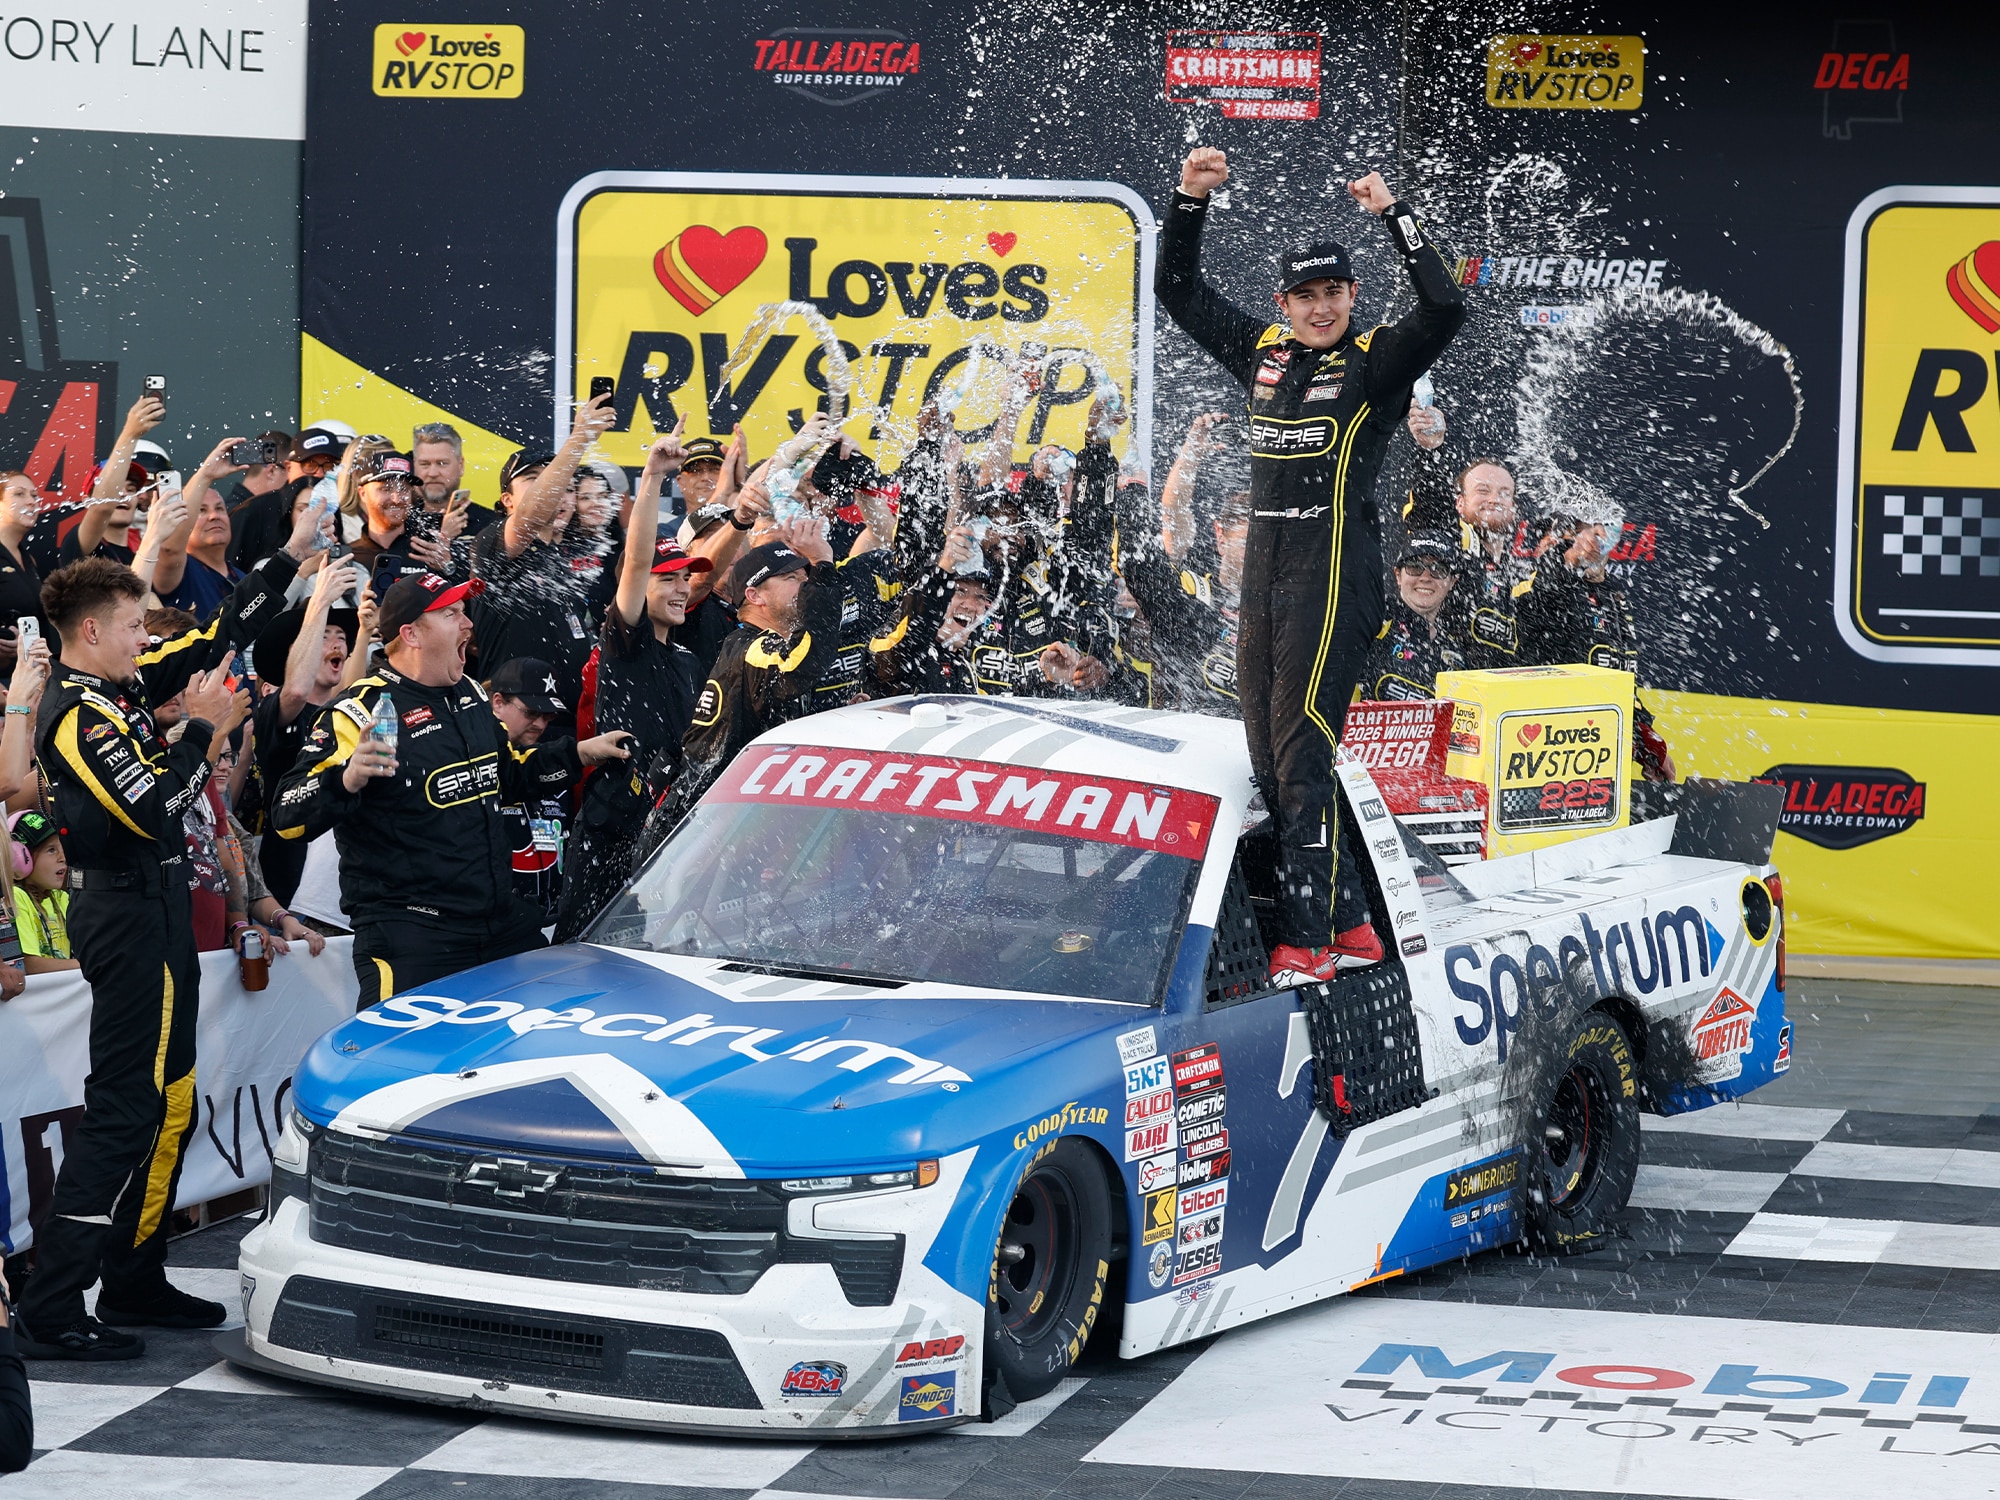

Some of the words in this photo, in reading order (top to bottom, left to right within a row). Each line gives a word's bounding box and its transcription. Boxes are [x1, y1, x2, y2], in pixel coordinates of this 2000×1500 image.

[0, 16, 114, 64] ORY
[132, 23, 265, 73] LANE
[753, 39, 920, 75] TALLADEGA
[381, 60, 434, 89] RV
[431, 62, 515, 91] STOP
[774, 73, 904, 86] SUPERSPEEDWAY
[1172, 56, 1313, 80] CRAFTSMAN
[1814, 53, 1910, 90] DEGA
[1210, 87, 1241, 99] TRUCK
[1241, 88, 1275, 99] SERIES
[1495, 71, 1551, 101] RV
[1546, 74, 1634, 102] STOP
[1235, 102, 1260, 117] THE
[1261, 103, 1309, 118] CHASE
[1291, 256, 1336, 272] Spectrum
[1499, 257, 1559, 287] THE
[1560, 257, 1667, 290] CHASE
[606, 330, 800, 437] RV
[1891, 347, 2000, 453] R
[306, 437, 328, 447] GUNK
[239, 591, 267, 620] sparco
[410, 723, 442, 739] GOODYEAR
[1347, 709, 1435, 726] CRAFTSMAN
[86, 722, 113, 741] SUNOCO
[1344, 726, 1382, 742] 2026
[1383, 724, 1436, 740] WINNER
[104, 746, 129, 767] TWG
[1506, 750, 1548, 780] RV
[1545, 747, 1611, 777] STOP
[116, 763, 143, 788] COMETIC
[128, 782, 147, 800] Mobil
[739, 753, 1172, 842] CRAFTSMAN
[1539, 777, 1613, 811] 225
[1753, 779, 1923, 816] LLADEGA
[1361, 801, 1385, 820] TWG
[1568, 808, 1607, 819] TALLADEGA
[1781, 813, 1907, 829] UPERSPEEDWAY
[1444, 905, 1710, 1065] Spectrum
[356, 995, 946, 1086] Spectrum
[1122, 1047, 1137, 1060] RACE
[1137, 1043, 1155, 1056] TRUCK
[1695, 1018, 1748, 1061] TIBBETTS
[1176, 1058, 1220, 1081] CRAFTSMAN
[1567, 1026, 1636, 1099] GOODYEAR
[1128, 1060, 1167, 1094] SKF
[1126, 1091, 1172, 1123] CALICO
[1178, 1094, 1225, 1122] COMETIC
[1013, 1101, 1109, 1151] GOODYEAR
[1182, 1121, 1220, 1144] LINCOLN
[1190, 1137, 1224, 1156] WELDERS
[1179, 1157, 1213, 1184] Holley
[1461, 1160, 1518, 1198] GAINBRIDGE
[1181, 1187, 1225, 1214] tilton
[1144, 1227, 1173, 1243] KENNAMETAL
[1179, 1215, 1221, 1246] KOOKS
[1175, 1242, 1221, 1276] JESEL
[1069, 1258, 1109, 1365] EAGLE
[894, 1360, 928, 1370] automotive
[942, 1354, 965, 1367] products
[895, 1335, 965, 1362] ARP
[783, 1370, 842, 1391] KBM
[1354, 1343, 1970, 1408] Mobil
[903, 1388, 953, 1406] SUNOCO
[1323, 1402, 1841, 1448] VICTORY
